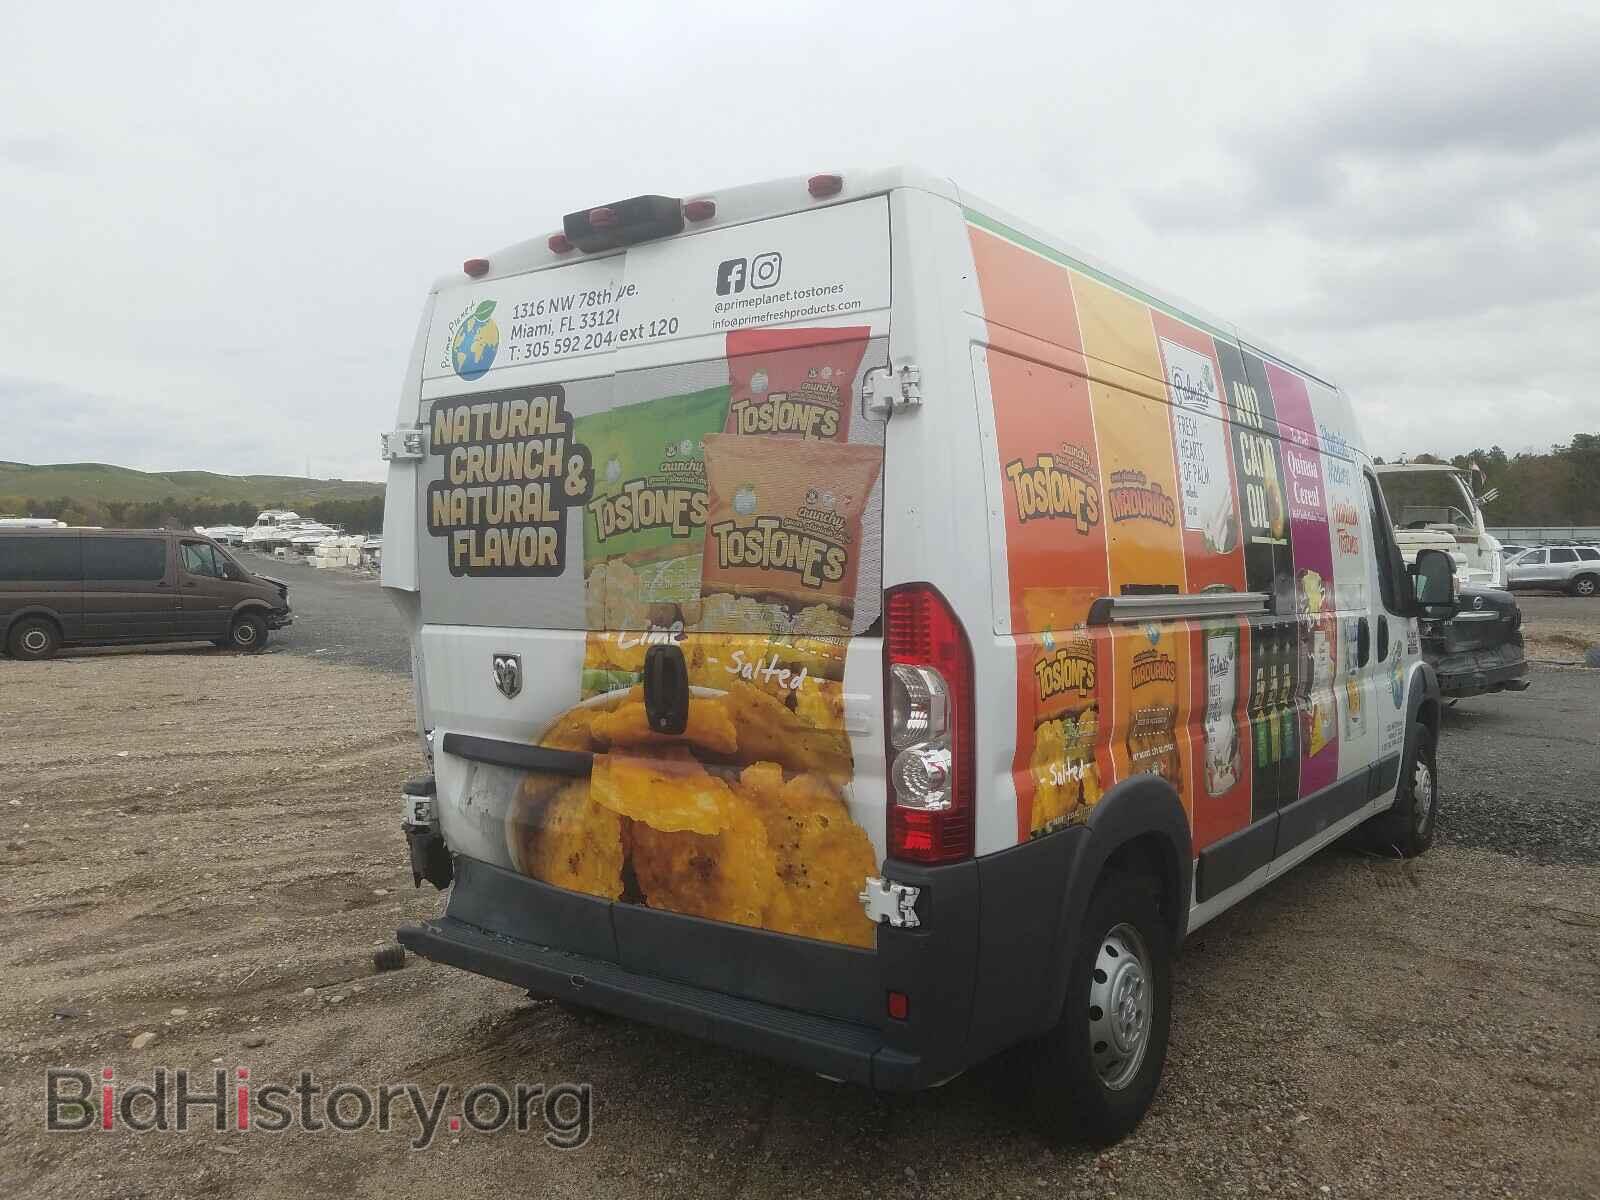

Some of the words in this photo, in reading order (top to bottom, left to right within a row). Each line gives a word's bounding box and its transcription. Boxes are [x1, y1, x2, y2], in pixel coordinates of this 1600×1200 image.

[512, 302, 544, 320] 1316
[549, 294, 576, 314] NW
[578, 288, 612, 310] 78th
[712, 300, 862, 329] info@primefreshproducts.com
[714, 283, 844, 313] @primeplanet.tostones
[509, 345, 521, 361] T:
[524, 341, 550, 360] 305
[554, 337, 580, 356] 592
[620, 323, 645, 342] ext
[648, 317, 679, 338] 120
[510, 318, 554, 341] Miami,
[559, 314, 576, 332] FL
[434, 396, 566, 445] NATURAL
[450, 438, 564, 485] CRUNCH
[565, 455, 588, 496] &
[432, 483, 560, 527] NATURAL
[1246, 484, 1270, 529] OIL
[1294, 481, 1321, 508] Cereal
[453, 527, 560, 567] FLAVOR
[725, 651, 808, 690] Salted
[1050, 756, 1085, 786] Salted
